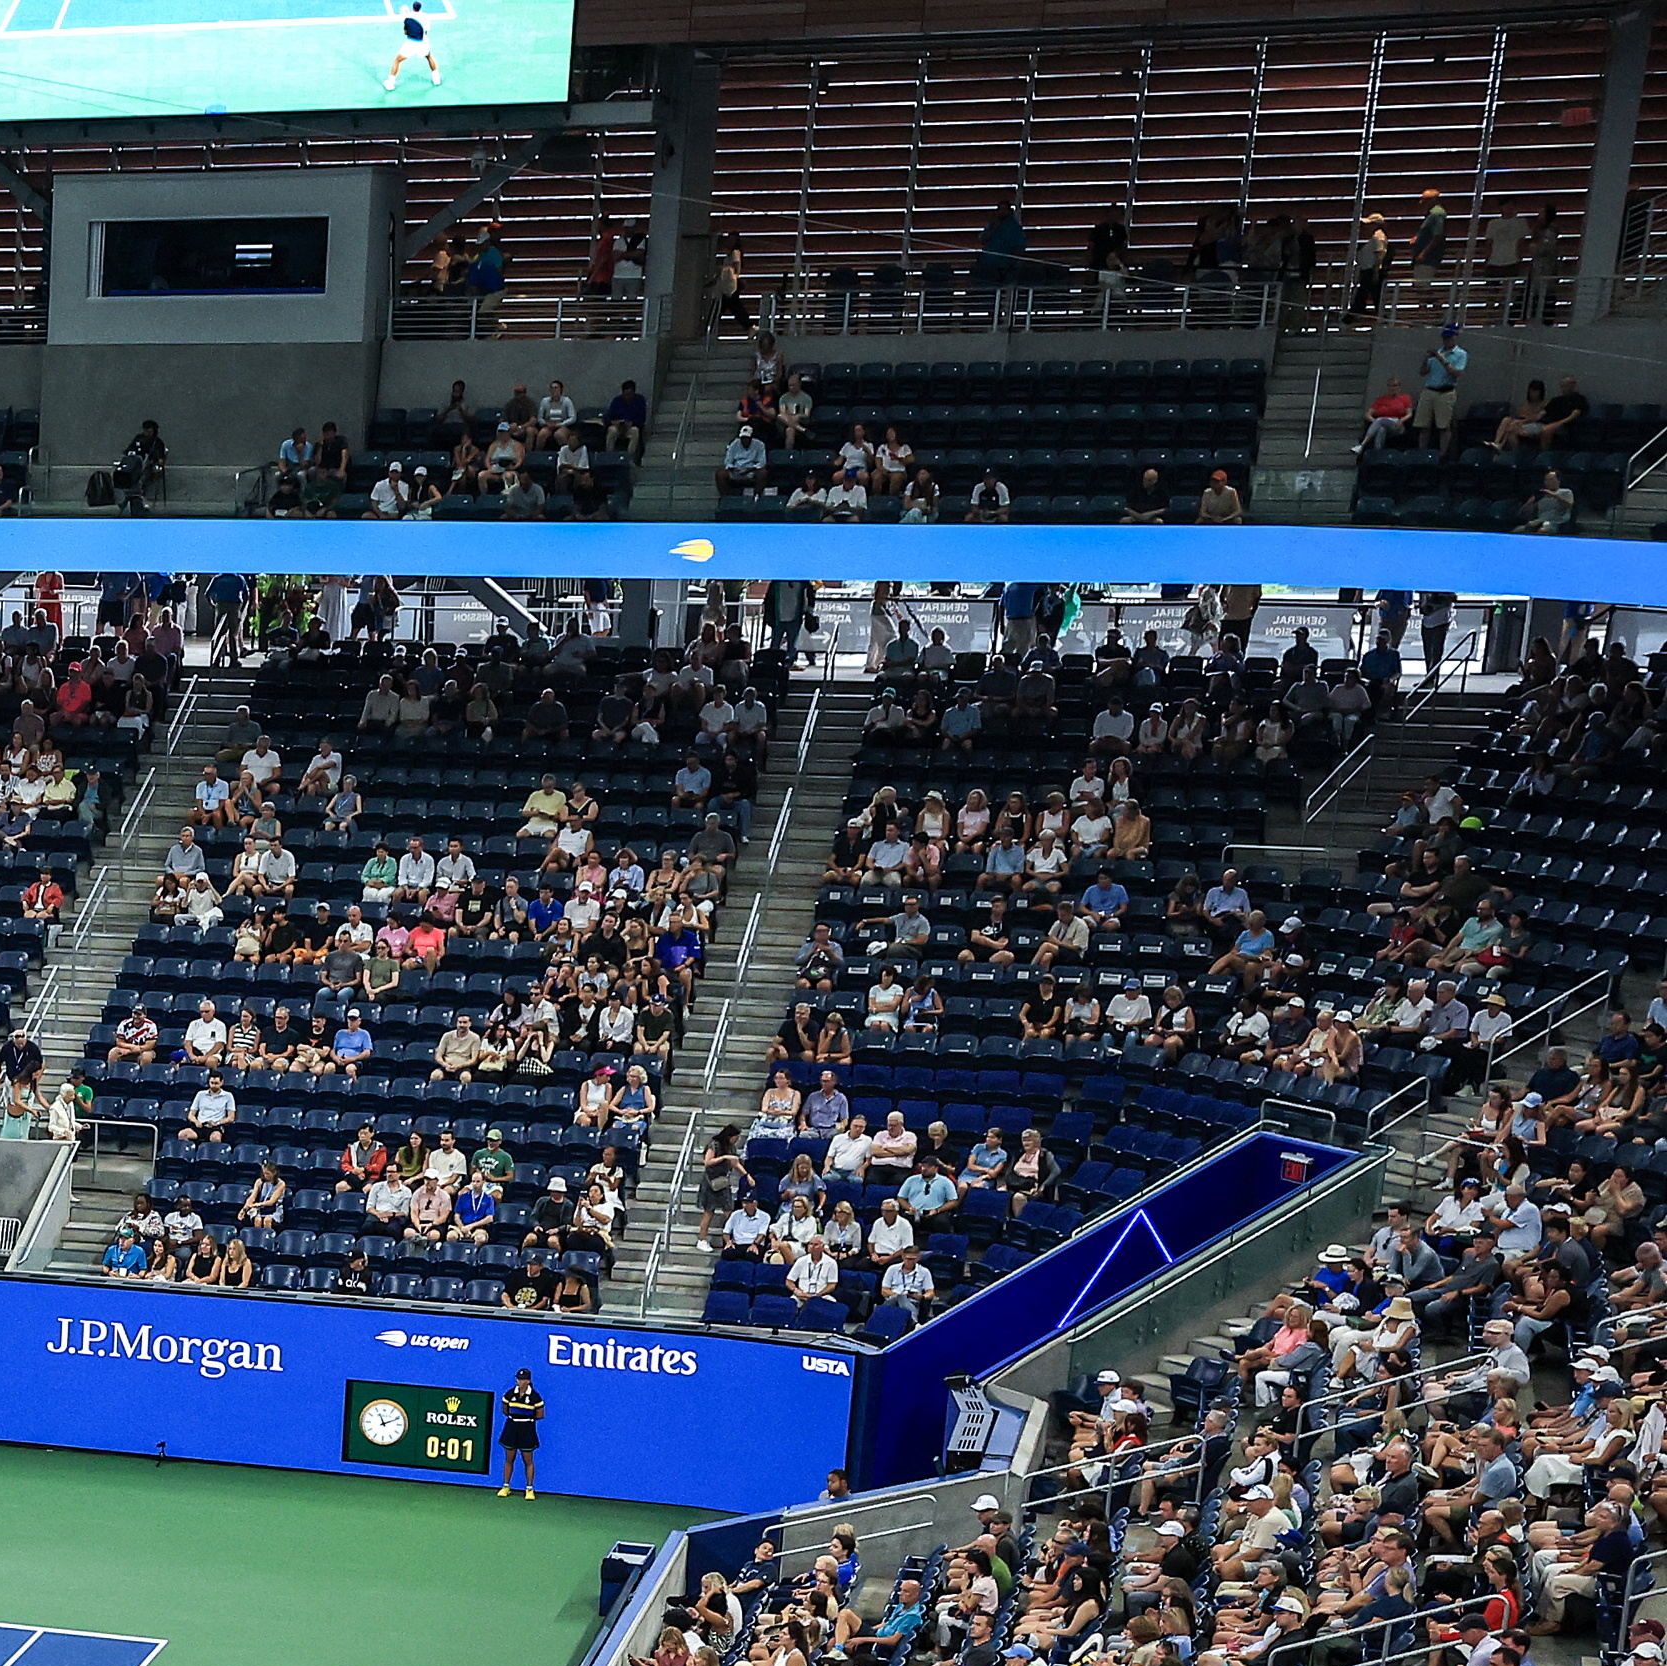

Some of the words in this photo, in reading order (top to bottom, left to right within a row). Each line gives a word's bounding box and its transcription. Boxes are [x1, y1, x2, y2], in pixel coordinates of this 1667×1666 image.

[46, 1317, 284, 1379] J.P.Morgan
[410, 1332, 429, 1349] us
[430, 1334, 470, 1353] open
[548, 1334, 698, 1376] Emirates
[802, 1355, 850, 1377] USTA
[425, 1412, 478, 1428] ROLEX
[426, 1435, 474, 1462] 0:01
